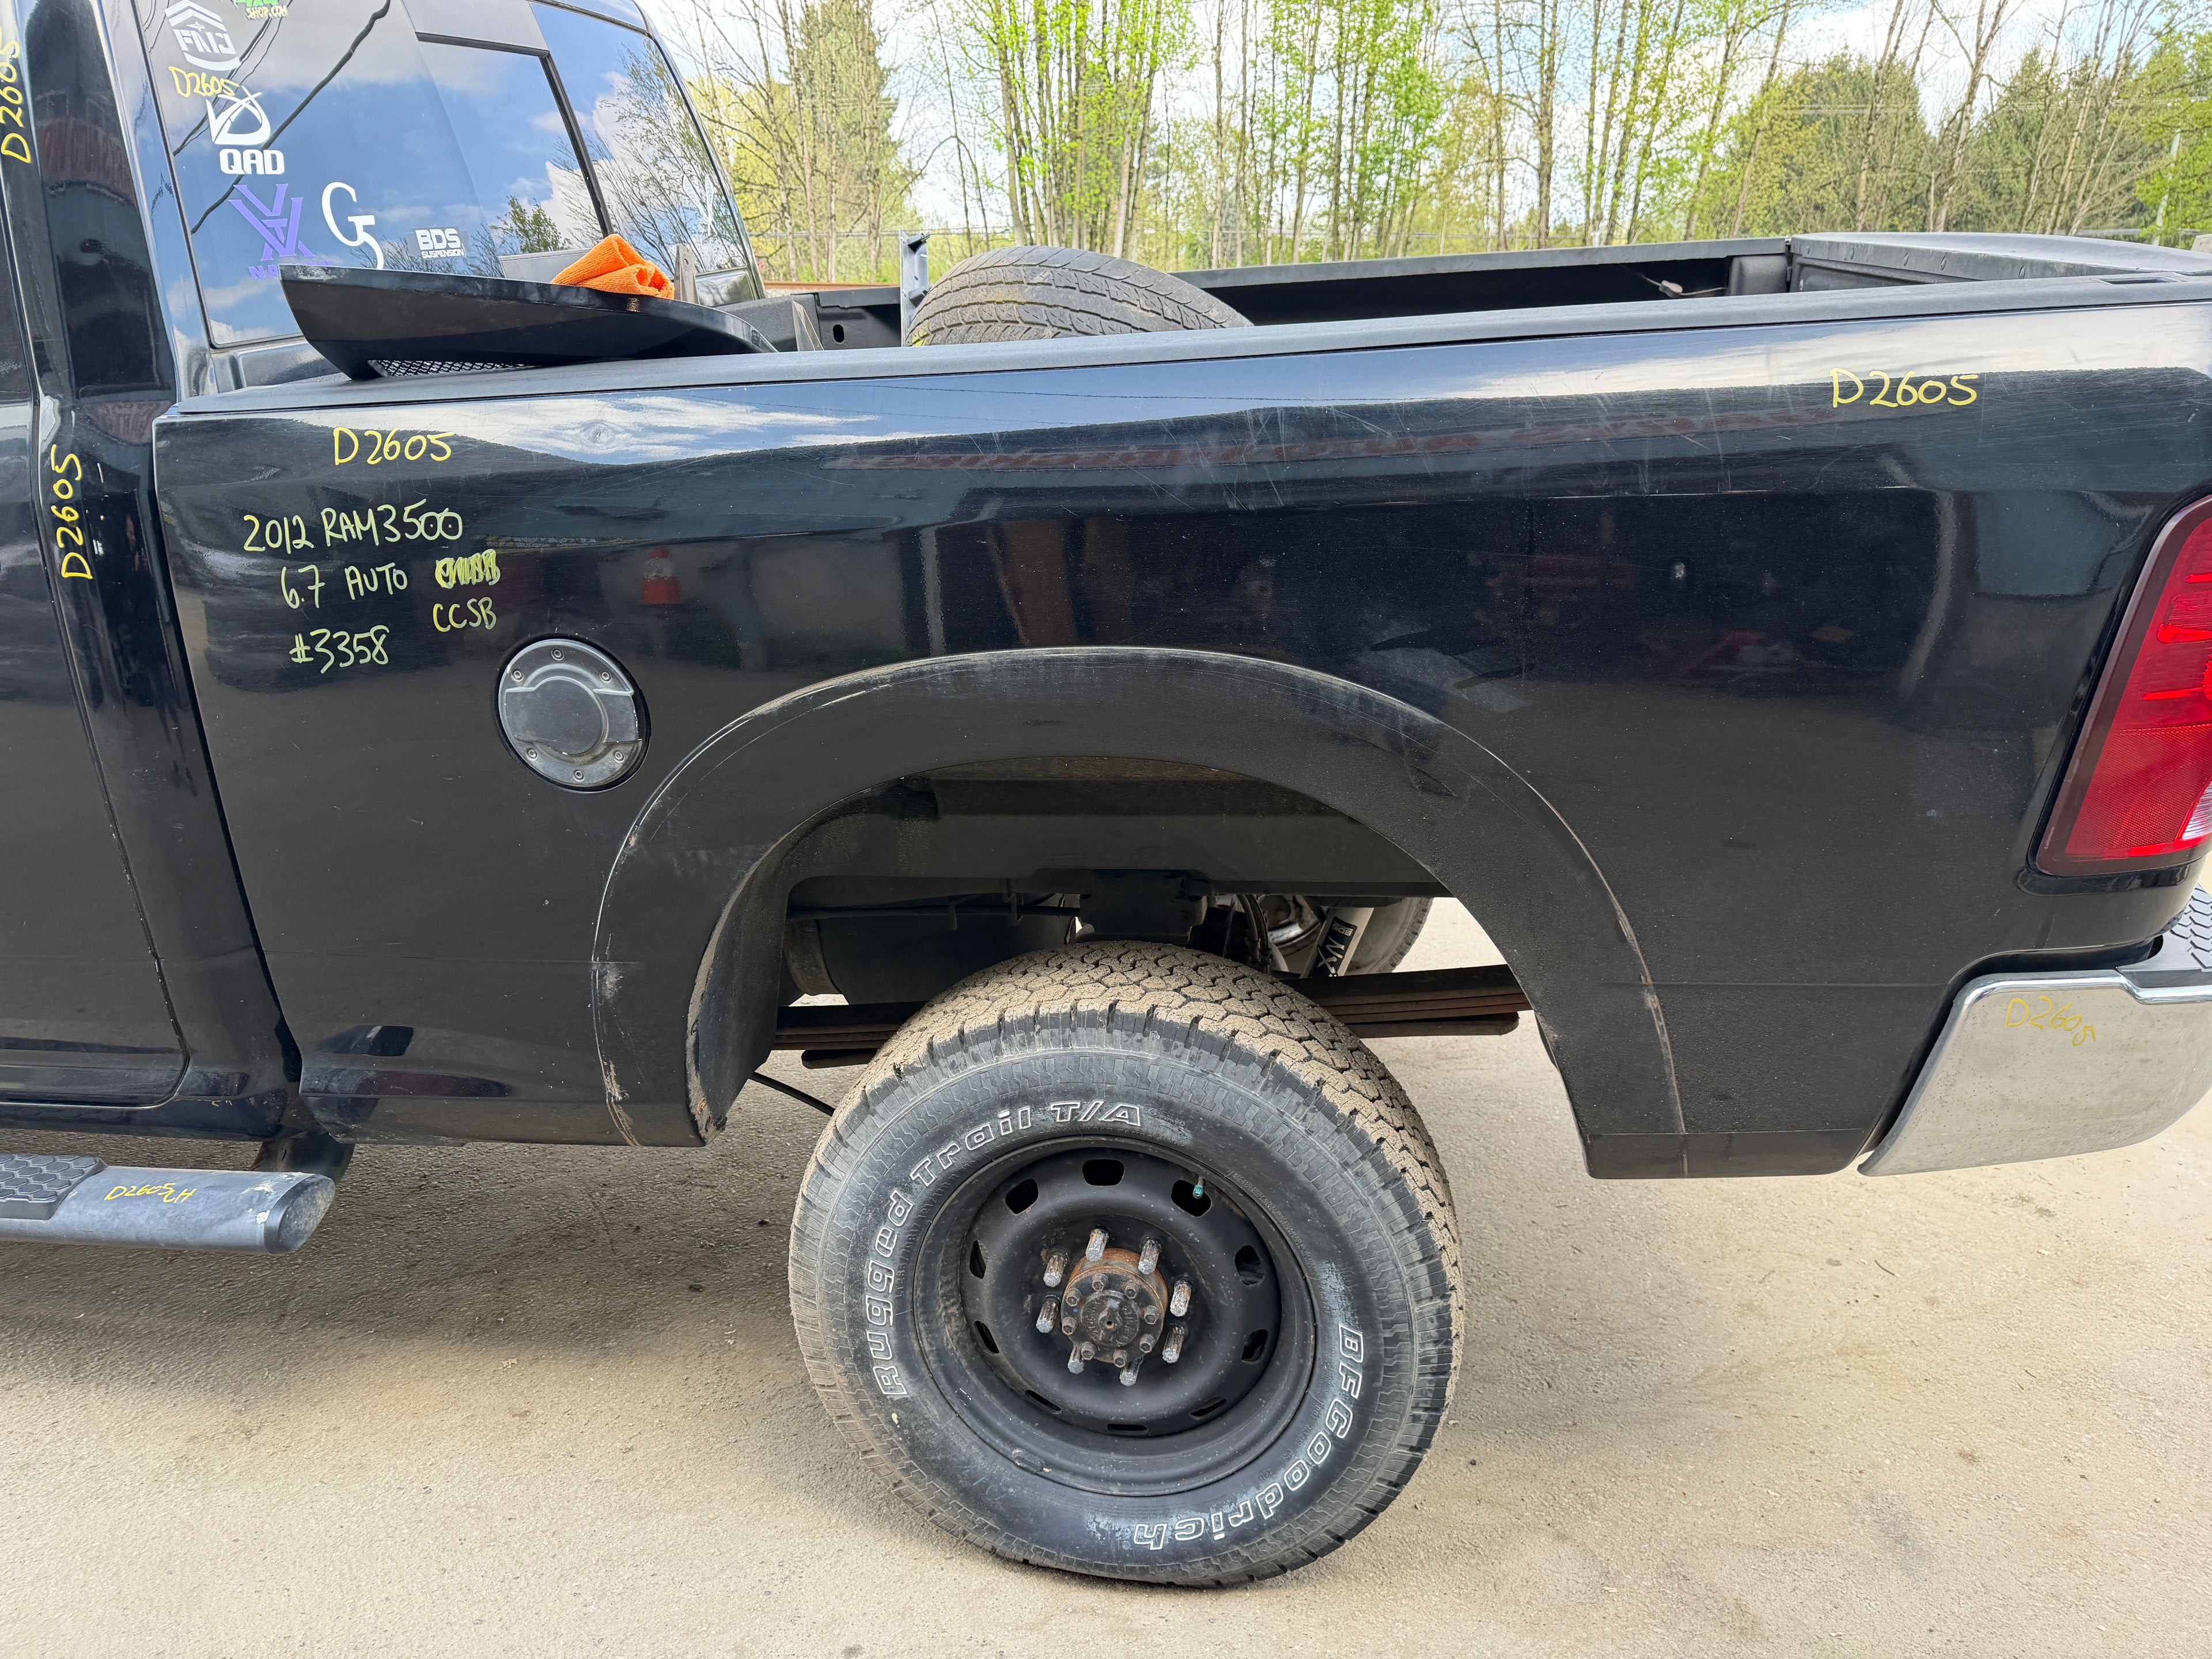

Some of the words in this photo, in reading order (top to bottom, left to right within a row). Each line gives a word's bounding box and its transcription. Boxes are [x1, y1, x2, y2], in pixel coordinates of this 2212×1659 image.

[168, 66, 240, 98] D2605
[219, 148, 285, 175] QAD
[415, 228, 461, 251] BDS
[421, 248, 465, 259] SUSPENSION
[1830, 368, 1979, 408] D2605
[333, 426, 456, 465] D2605
[50, 444, 94, 579] D2605
[243, 514, 315, 554] 2012
[281, 564, 325, 609] 6.7
[344, 562, 408, 600] AUTO
[433, 596, 497, 632] CCSB
[289, 624, 390, 674] #3358
[2005, 995, 2097, 1047] D2605
[866, 1189, 914, 1396] Rugged
[910, 1105, 1032, 1187] Trail
[1050, 1100, 1142, 1127] T/A
[1132, 1323, 1364, 1551] BFGoodrich
